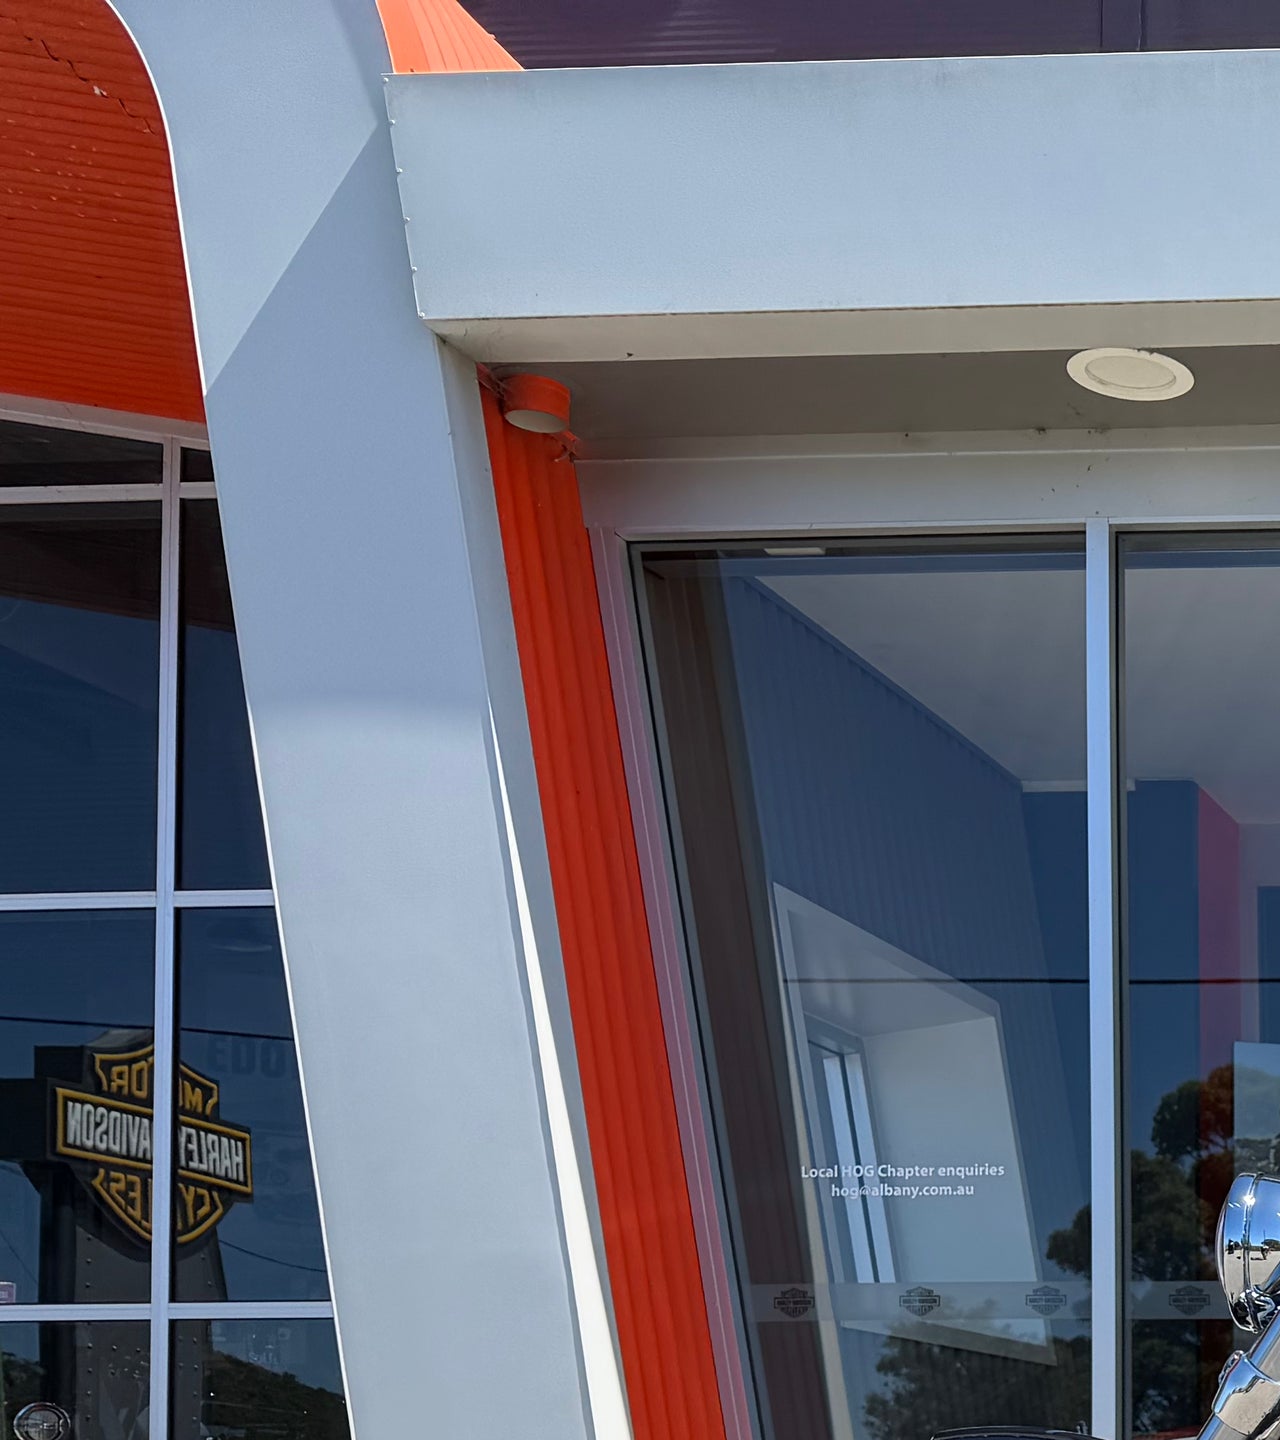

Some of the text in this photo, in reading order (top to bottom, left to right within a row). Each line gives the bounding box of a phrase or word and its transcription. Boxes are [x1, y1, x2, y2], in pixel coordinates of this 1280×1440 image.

[801, 1163, 1005, 1179] Local HOG Chapter enquiries
[831, 1183, 975, 1199] hog@albany.com.au
